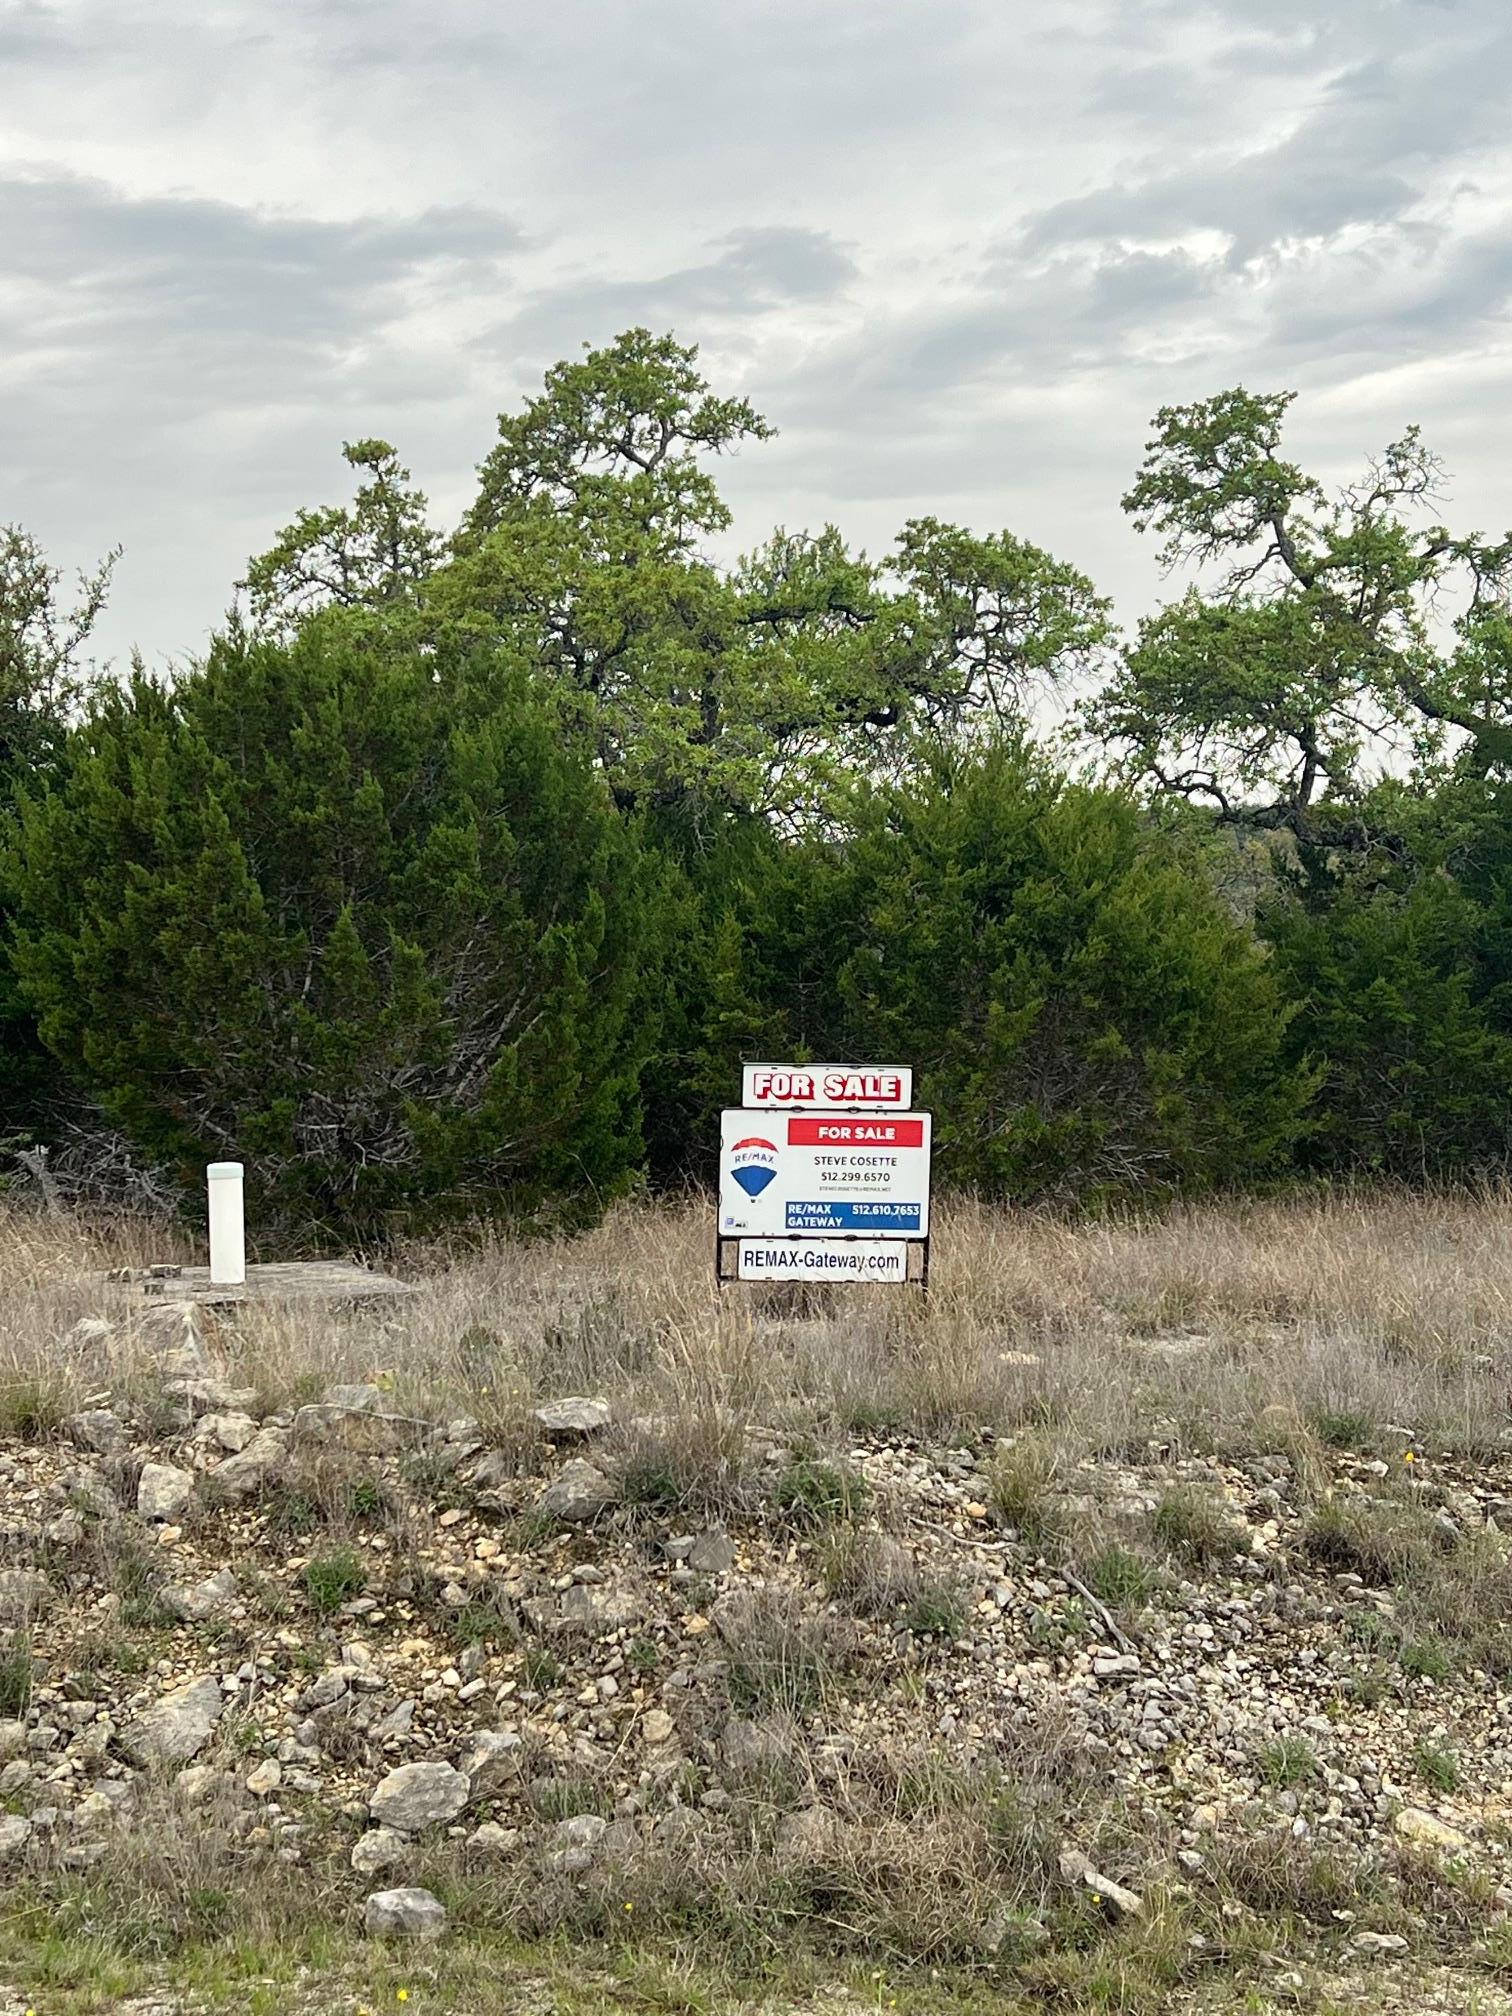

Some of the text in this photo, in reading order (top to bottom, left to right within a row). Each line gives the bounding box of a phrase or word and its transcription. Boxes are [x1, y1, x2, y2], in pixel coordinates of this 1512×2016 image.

[754, 1073, 901, 1101] FOR SALE
[818, 1126, 895, 1140] FOR SALE
[735, 1153, 774, 1164] RE/MAX
[814, 1156, 897, 1166] STEVE COSETTE
[821, 1172, 890, 1182] 512.299.6570
[788, 1204, 919, 1215] RE/MAX 512.610.7653
[788, 1217, 842, 1227] GATEWAY
[744, 1250, 899, 1273] REMAX-Gateway.com
